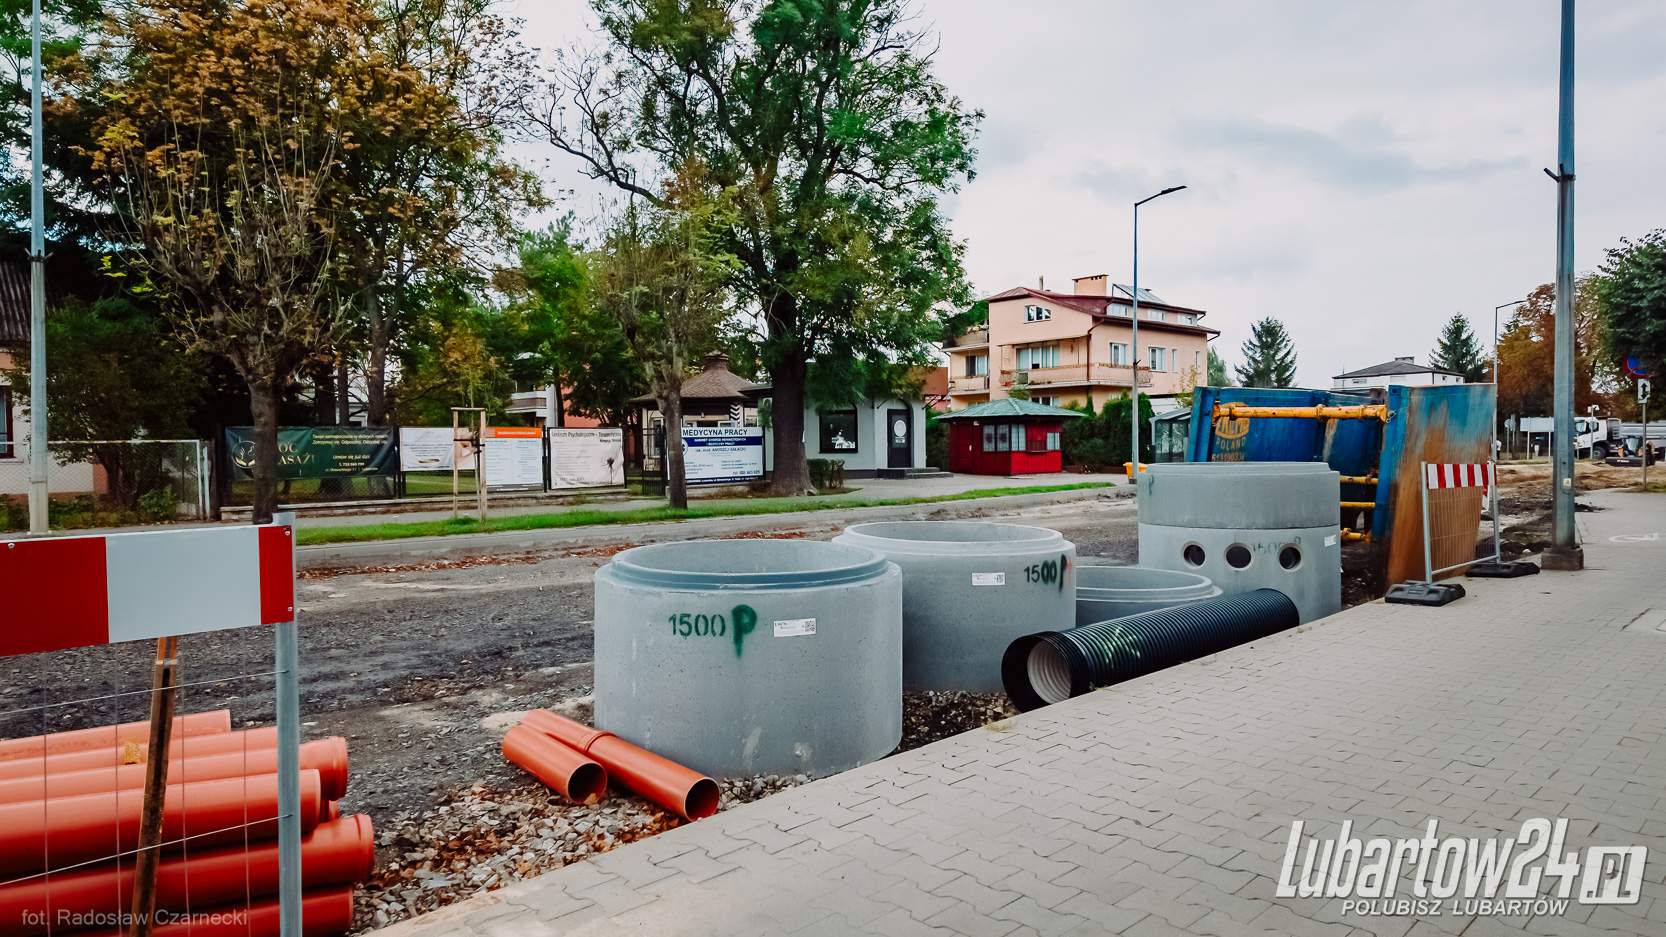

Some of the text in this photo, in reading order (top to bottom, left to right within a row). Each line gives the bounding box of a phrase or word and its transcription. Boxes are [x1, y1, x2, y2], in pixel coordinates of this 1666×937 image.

[683, 428, 748, 437] MEDYCYNA PRACY
[1023, 560, 1057, 584] 1500
[668, 613, 726, 638] 1500
